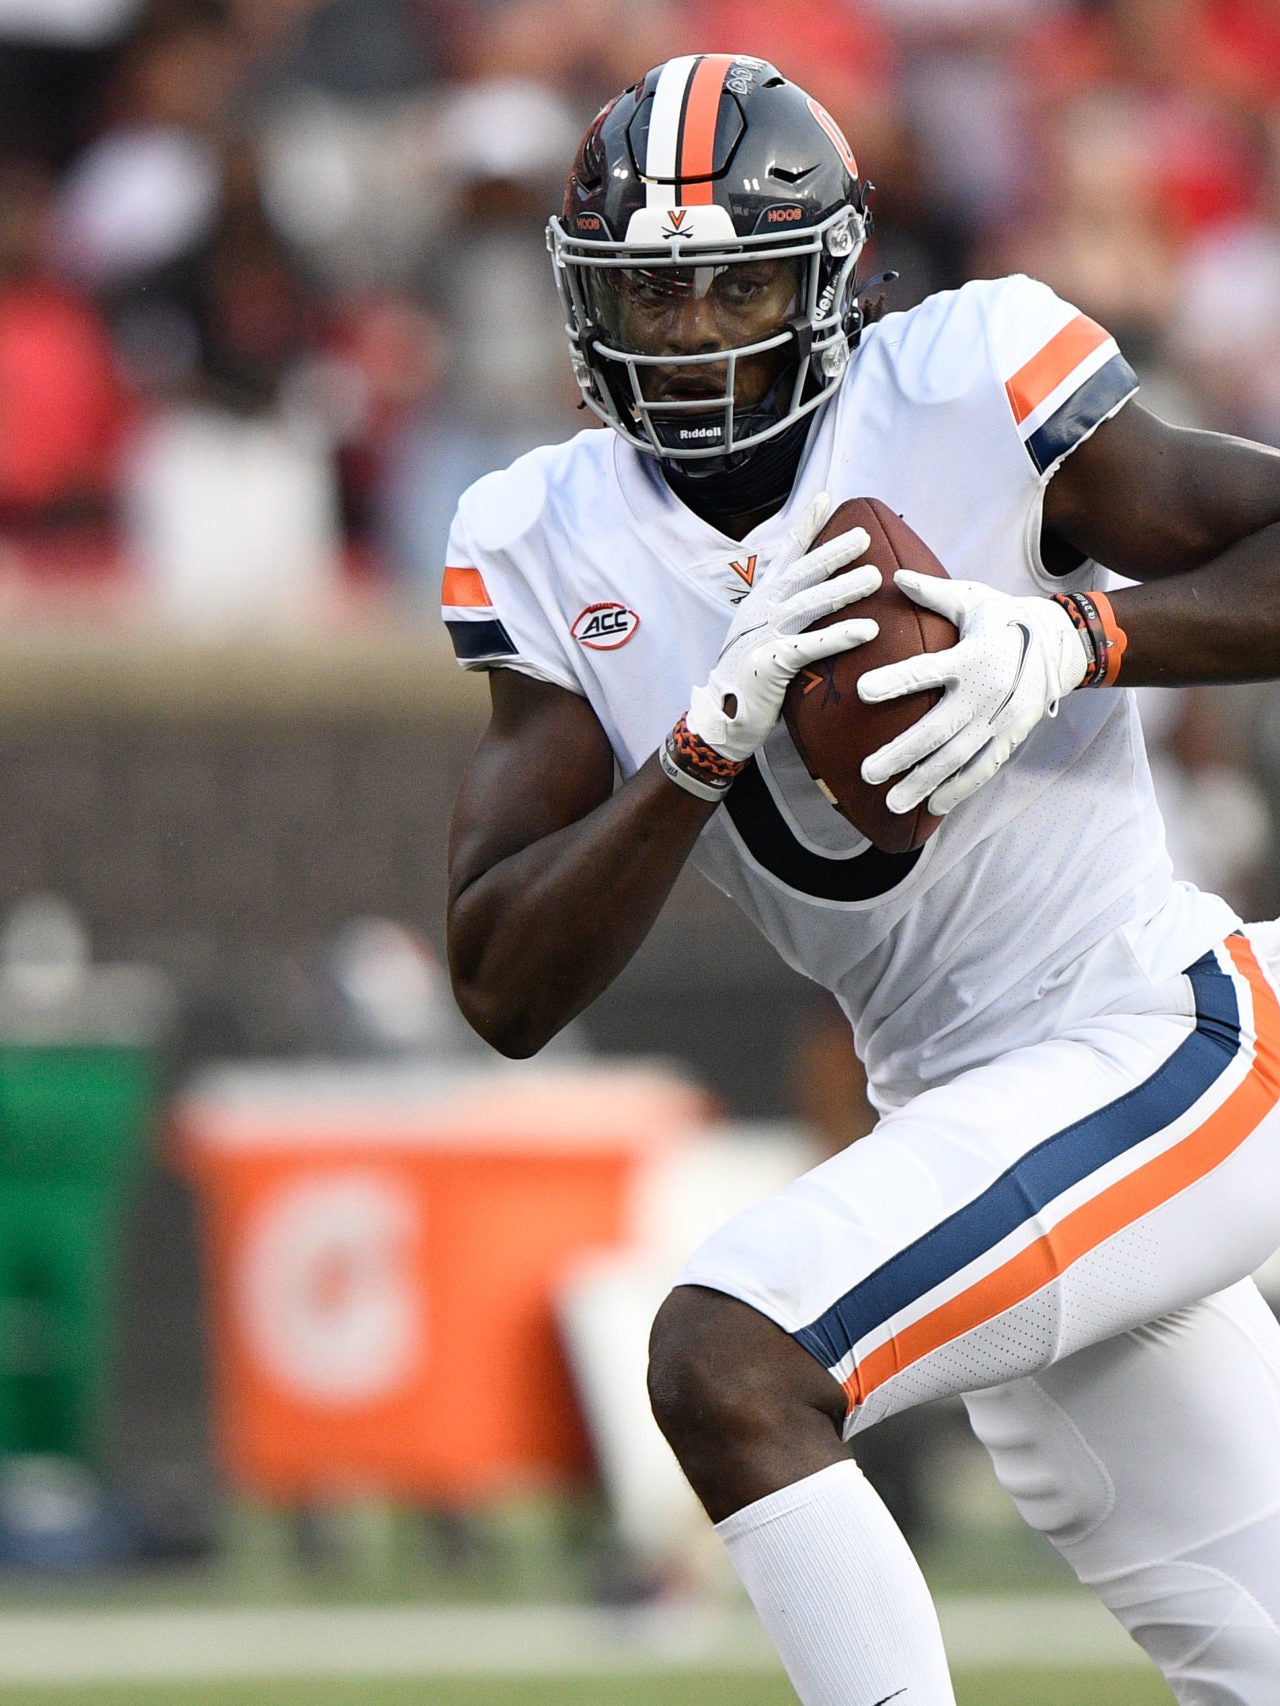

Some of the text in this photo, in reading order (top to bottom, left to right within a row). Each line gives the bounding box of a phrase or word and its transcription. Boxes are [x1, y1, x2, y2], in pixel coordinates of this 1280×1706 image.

[767, 208, 802, 223] HOOS
[680, 426, 722, 440] Riddell
[582, 609, 628, 635] ACC
